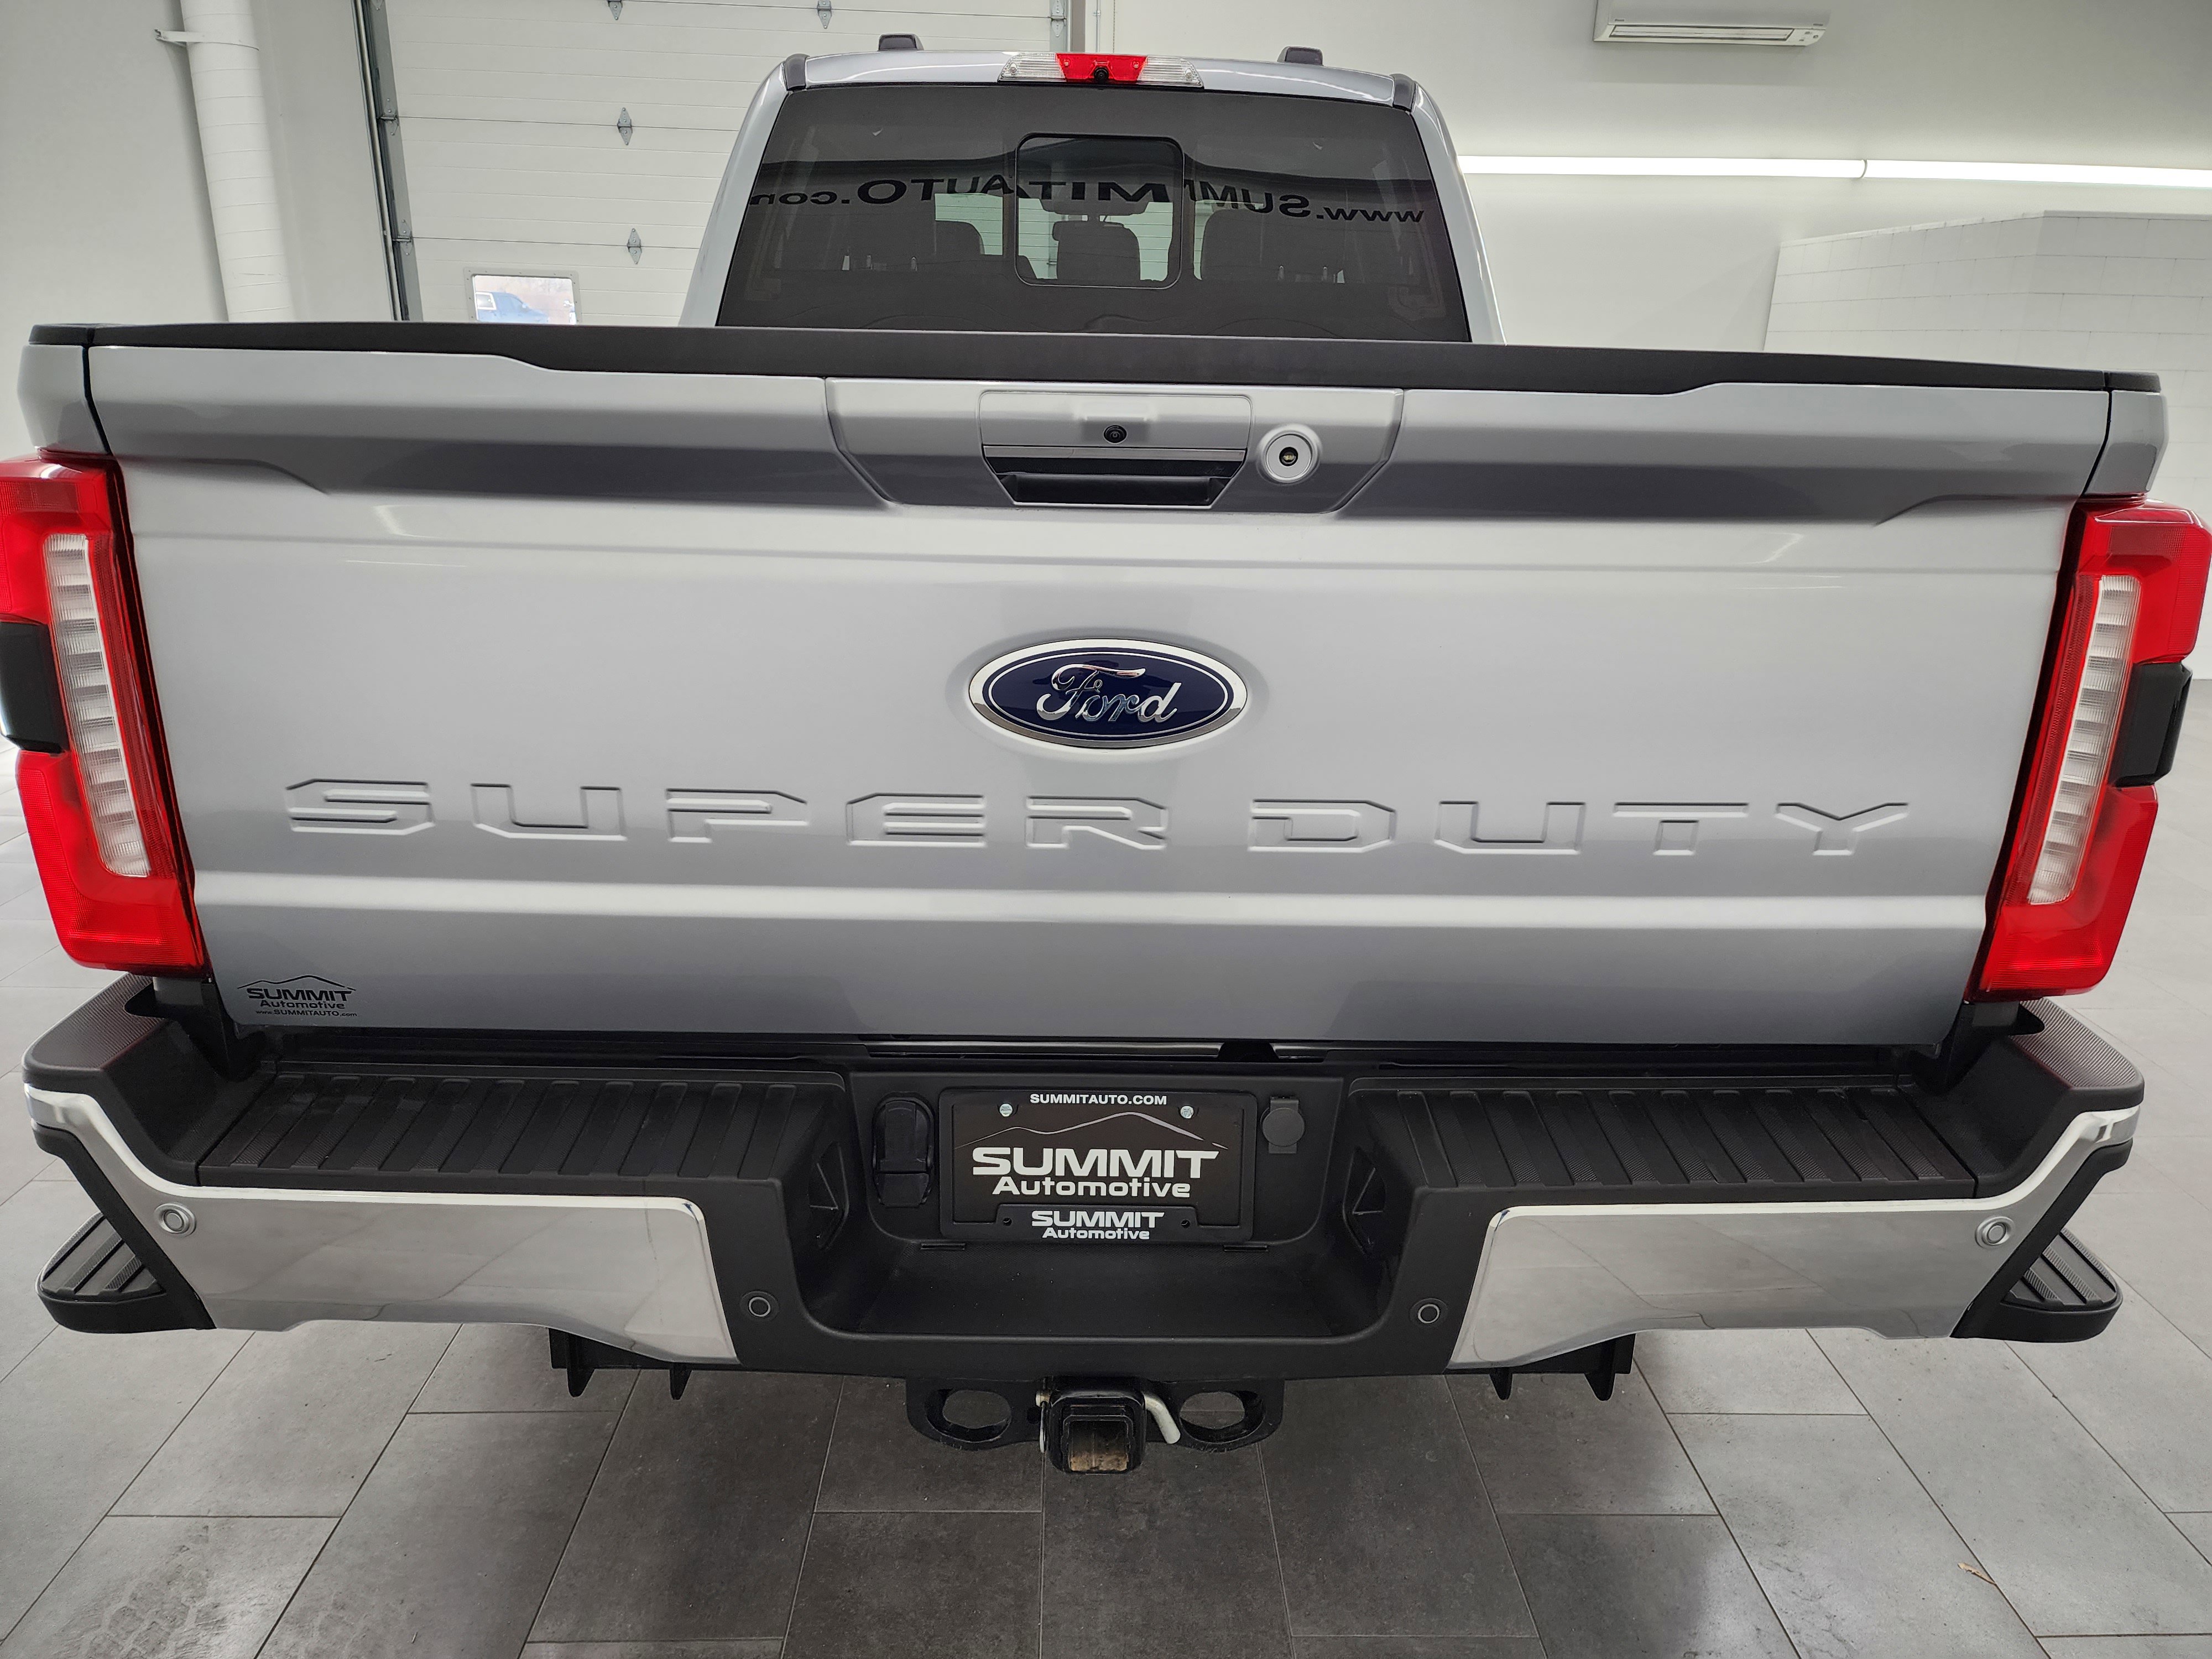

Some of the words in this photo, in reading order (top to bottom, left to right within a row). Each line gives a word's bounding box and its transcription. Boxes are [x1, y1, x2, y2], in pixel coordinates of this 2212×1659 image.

[1036, 664, 1182, 723] Ford
[285, 779, 1168, 849] SUPER
[1248, 798, 1910, 856] DUTY
[247, 988, 352, 1001] SUMMIT
[260, 1000, 346, 1009] Automotive
[1030, 1093, 1167, 1105] SUMMITAUTO.COM
[972, 1147, 1219, 1178] SUMMIT
[992, 1176, 1191, 1198] Automotive
[1031, 1210, 1165, 1228] SUMMIT
[1042, 1227, 1150, 1240] Automotive
